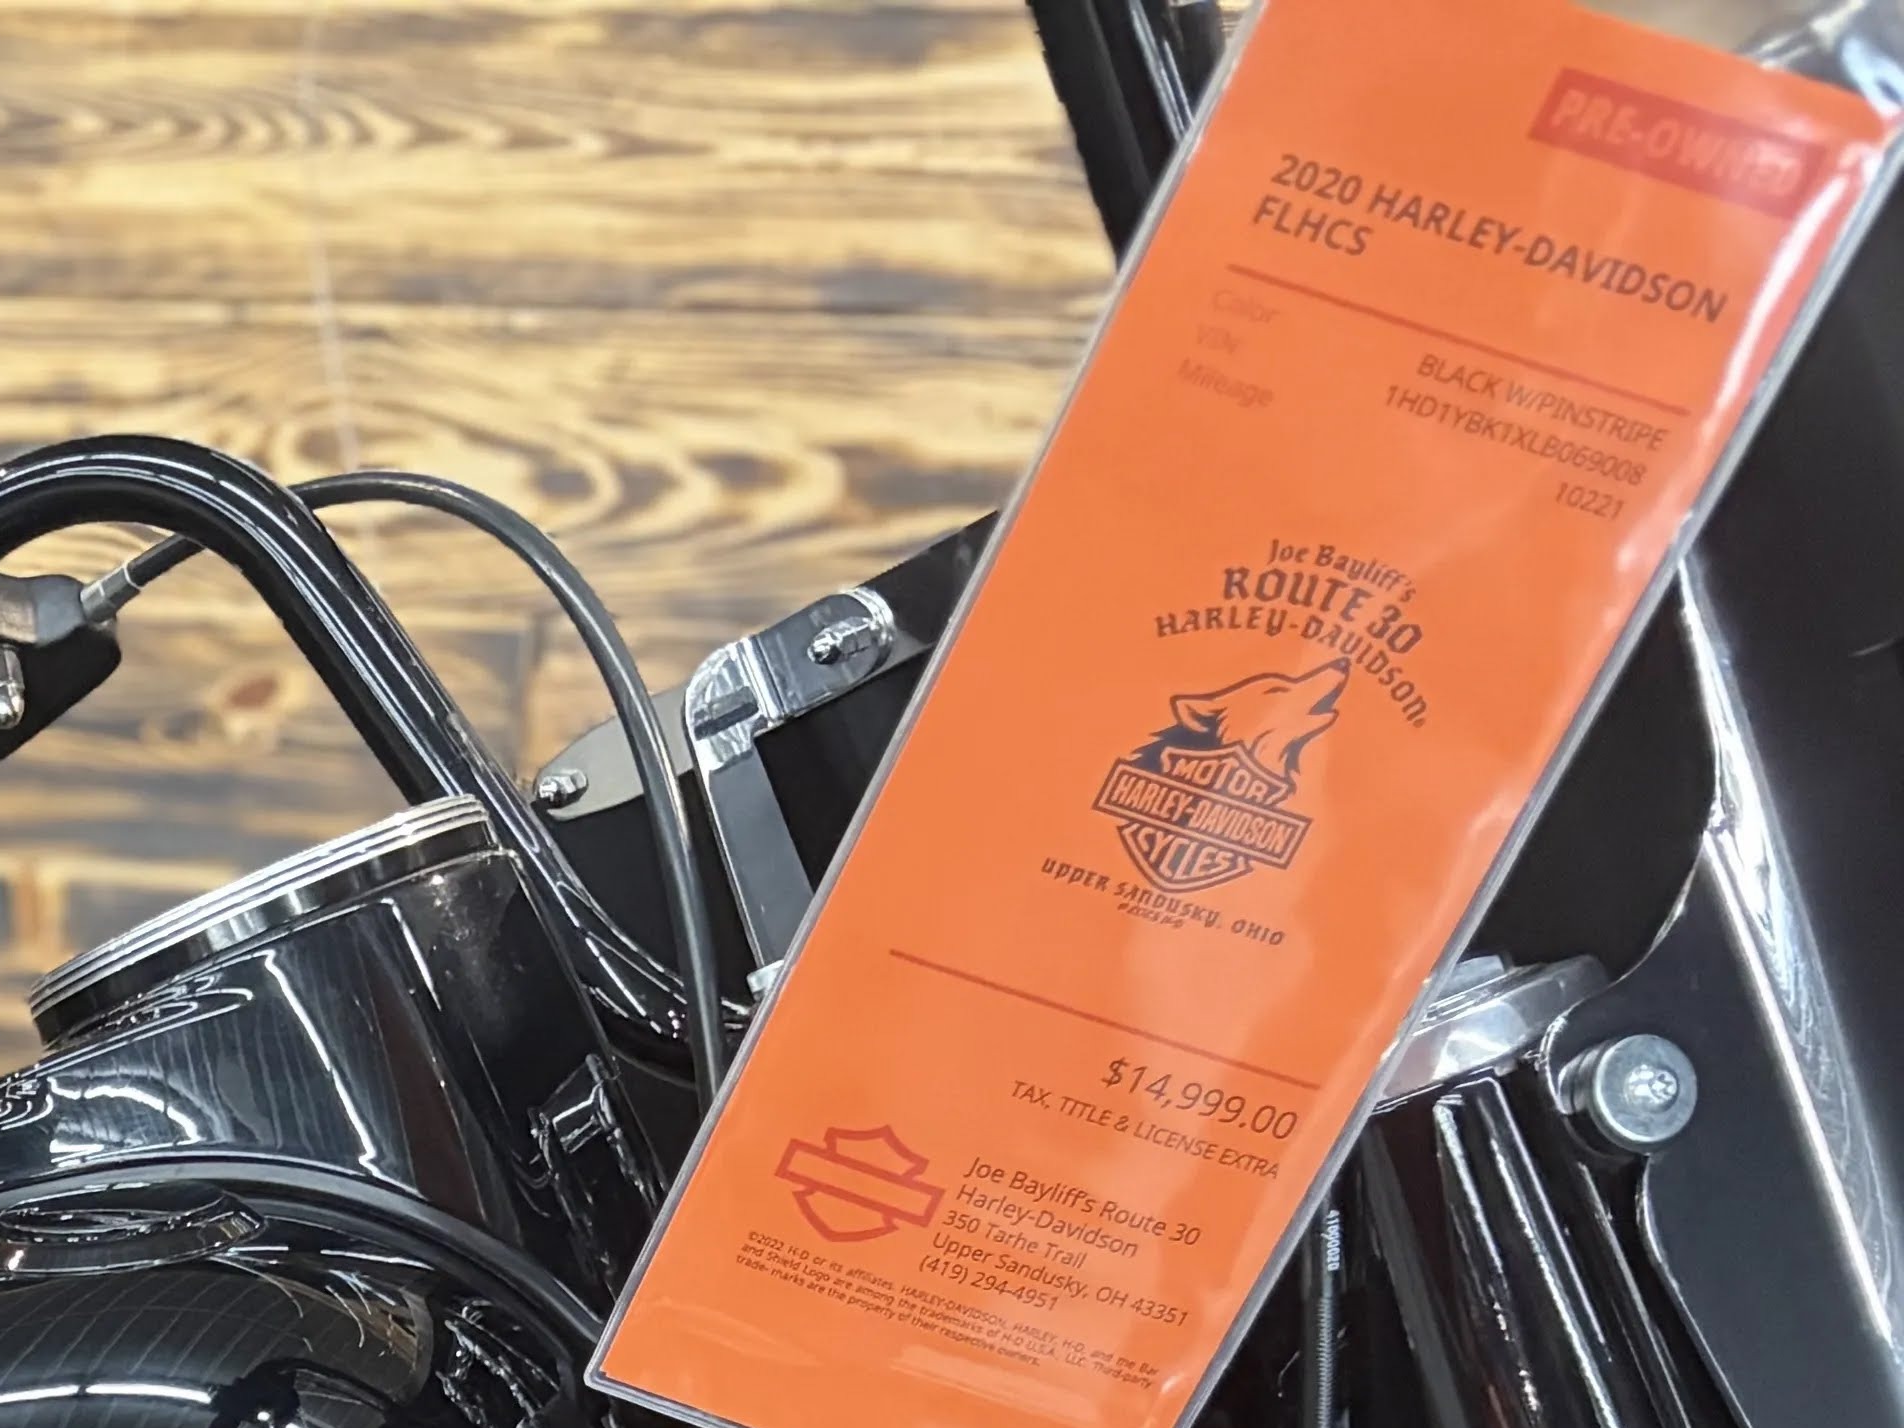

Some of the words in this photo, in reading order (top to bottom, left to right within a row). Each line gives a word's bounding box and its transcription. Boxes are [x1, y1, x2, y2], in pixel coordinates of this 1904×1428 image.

[1550, 87, 1804, 195] PRE-OWNED
[1251, 193, 1374, 256] FLHCS
[1269, 152, 1363, 206] 2020
[1365, 182, 1728, 324] HARLEY-DAVIDSON
[1175, 356, 1275, 409] Mileage
[1415, 352, 1504, 400] BLACK
[1496, 376, 1670, 452] W/PINSTRIPE
[1384, 383, 1647, 486] 1HD1YBK1XLB069008
[1553, 480, 1625, 520] 10221
[1265, 537, 1310, 577] Joe
[1314, 543, 1418, 603] Bayliff's
[1222, 567, 1370, 624] ROUTE
[1366, 604, 1423, 655] 30
[1113, 772, 1294, 858] HARLEY-DAVIDSON
[1170, 752, 1282, 805] MOTOR
[1130, 827, 1243, 874] CYCLES
[1040, 856, 1111, 892] UPPER
[1229, 918, 1286, 946] OHIO
[1010, 1079, 1053, 1110] TAX,
[1058, 1095, 1113, 1127] TITLE
[1111, 1113, 1133, 1135] &
[1131, 1117, 1220, 1160] LICENSE
[1216, 1147, 1279, 1179] EXTRA
[1099, 1055, 1298, 1140] $14,999.00
[938, 1207, 983, 1236] 350
[983, 1221, 1039, 1256] Tarhe
[1038, 1241, 1088, 1272] Trail
[954, 1182, 1139, 1258] Harley-Davidson
[961, 1155, 1006, 1184] Joe
[1007, 1169, 1098, 1215] Bayliff's
[1097, 1199, 1171, 1237] Route
[1165, 1220, 1204, 1248] 30
[799, 1262, 833, 1284] Logo
[804, 1278, 828, 1295] are
[810, 1253, 829, 1267] or
[918, 1253, 969, 1285] (419)
[969, 1270, 1060, 1311] 294-4951
[931, 1230, 995, 1264] Upper
[993, 1252, 1089, 1299] Sandusky,
[1093, 1283, 1131, 1310] OH
[1129, 1297, 1192, 1327] 43351
